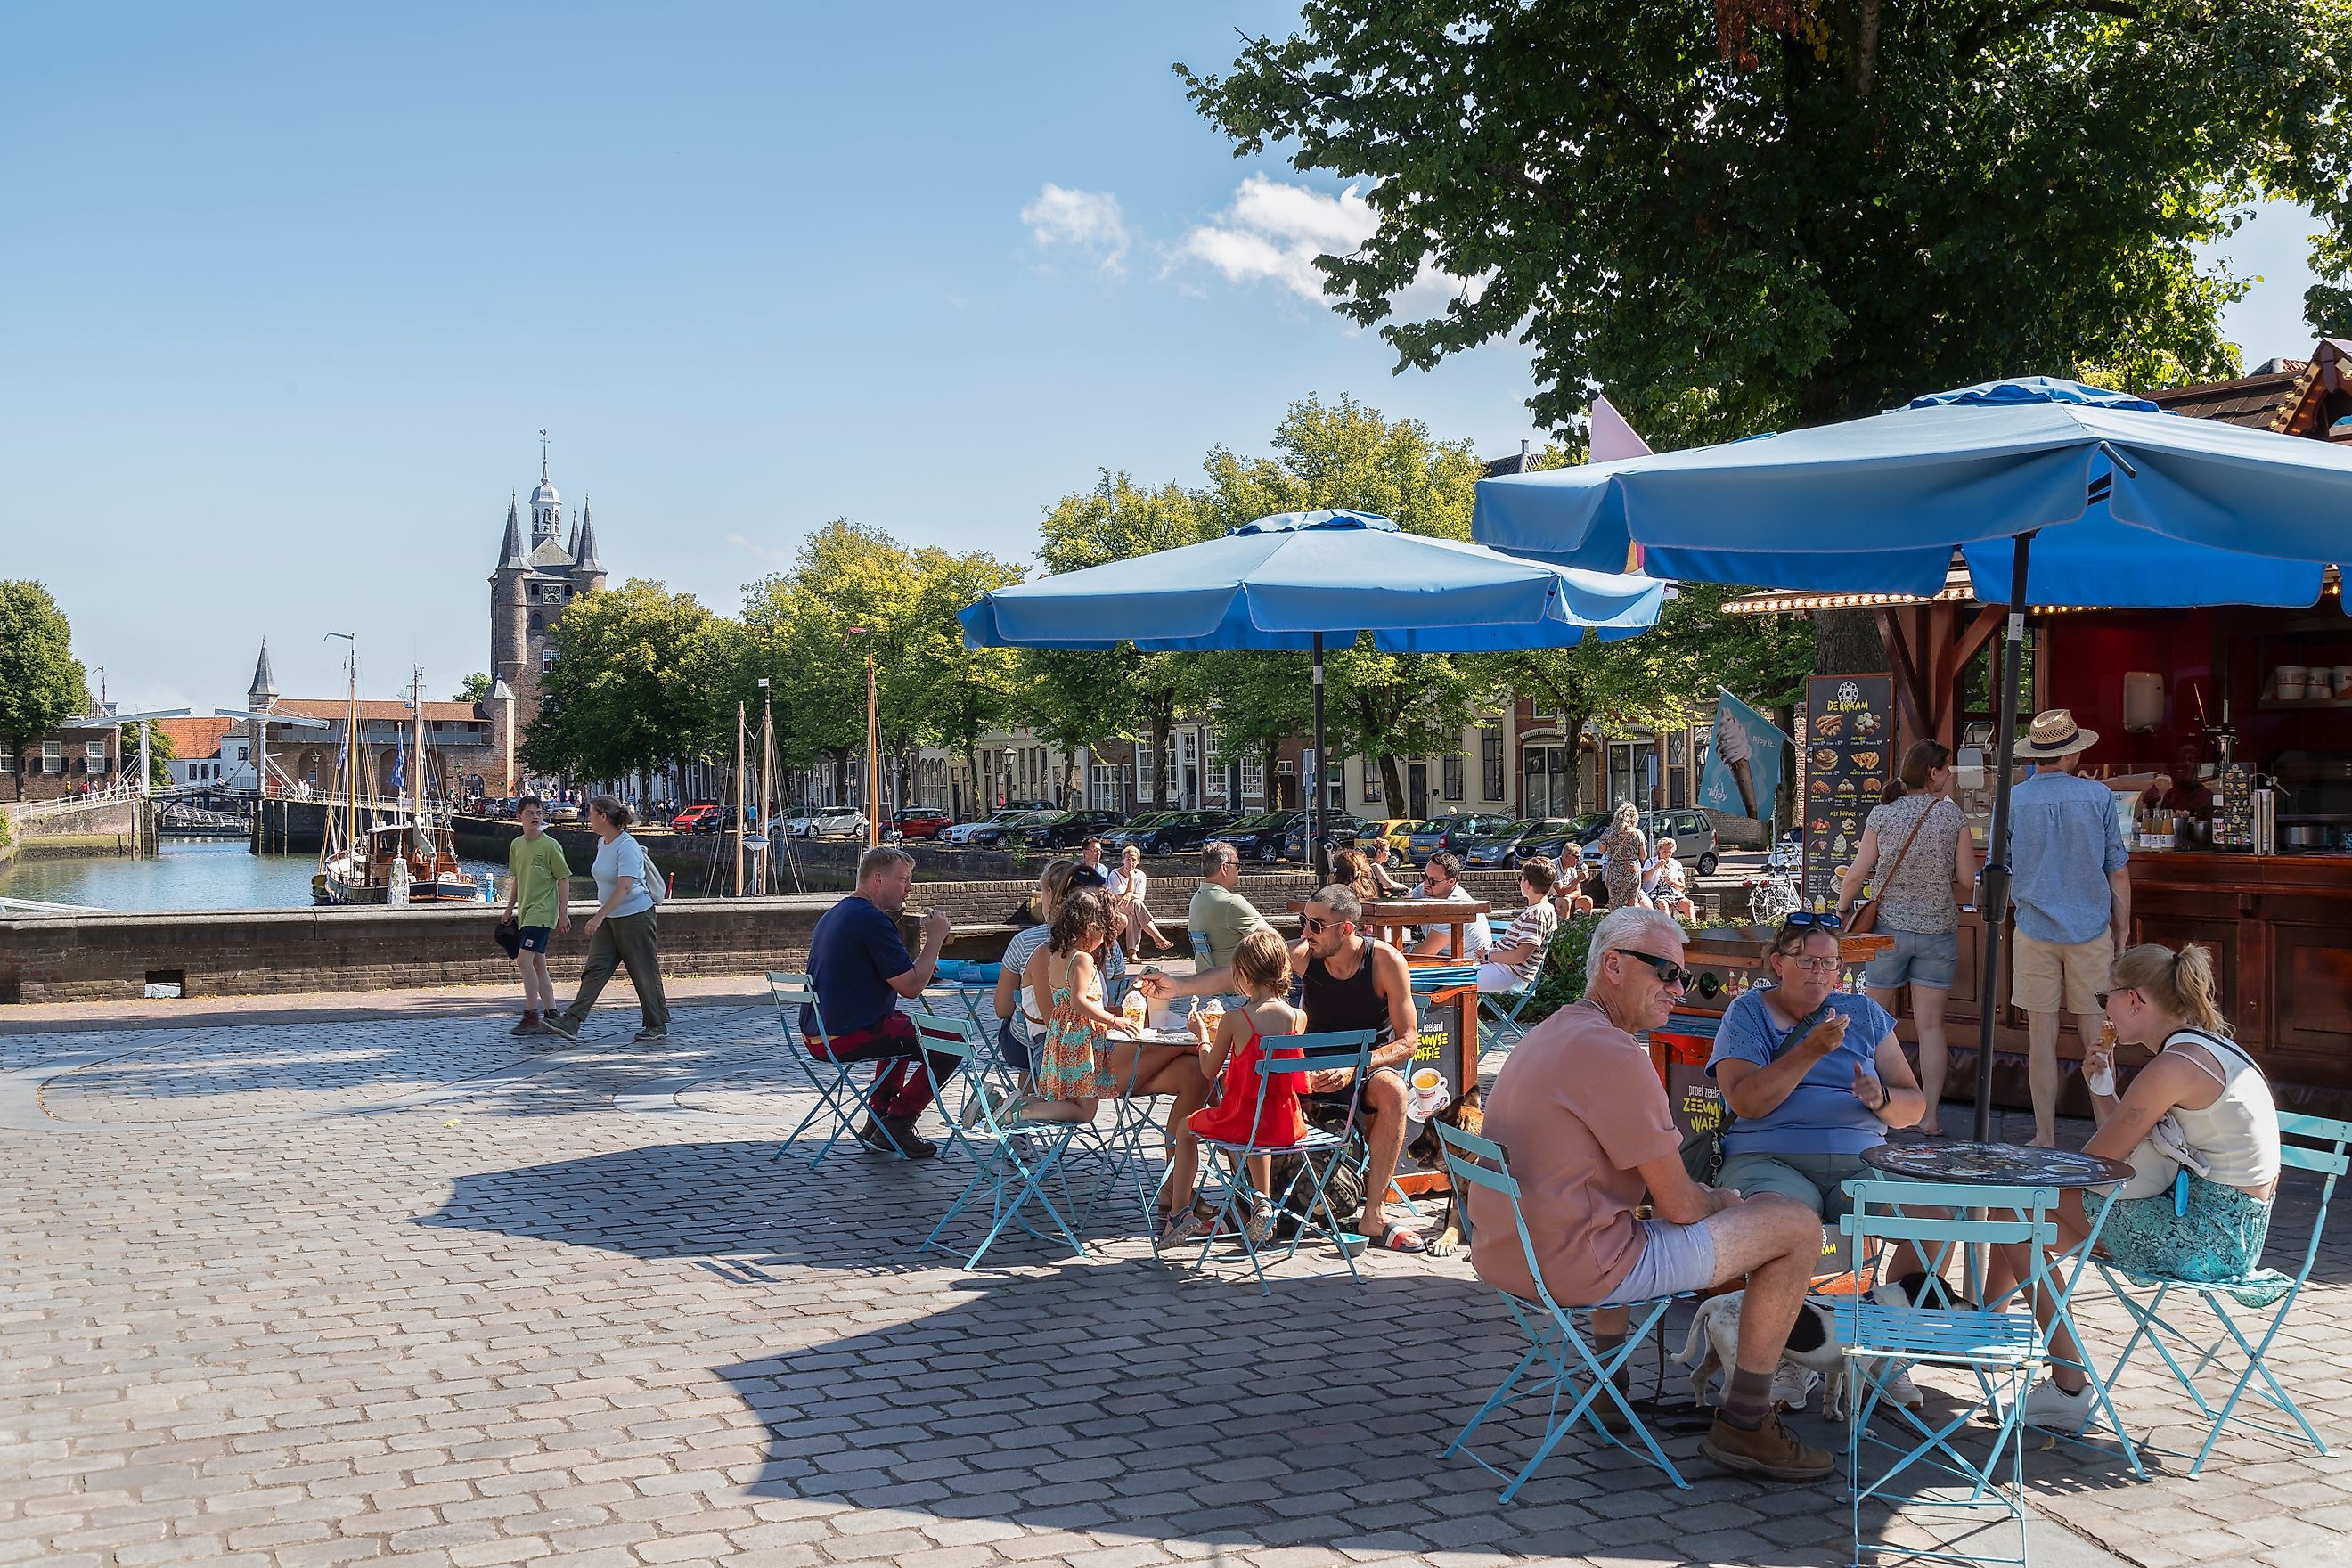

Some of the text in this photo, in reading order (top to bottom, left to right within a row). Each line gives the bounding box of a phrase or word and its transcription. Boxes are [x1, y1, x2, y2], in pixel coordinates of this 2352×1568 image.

[1827, 699, 1869, 713] DE KRAAM
[1688, 1084, 1721, 1099] proef zeela
[1683, 1097, 1723, 1119] ZEEUW
